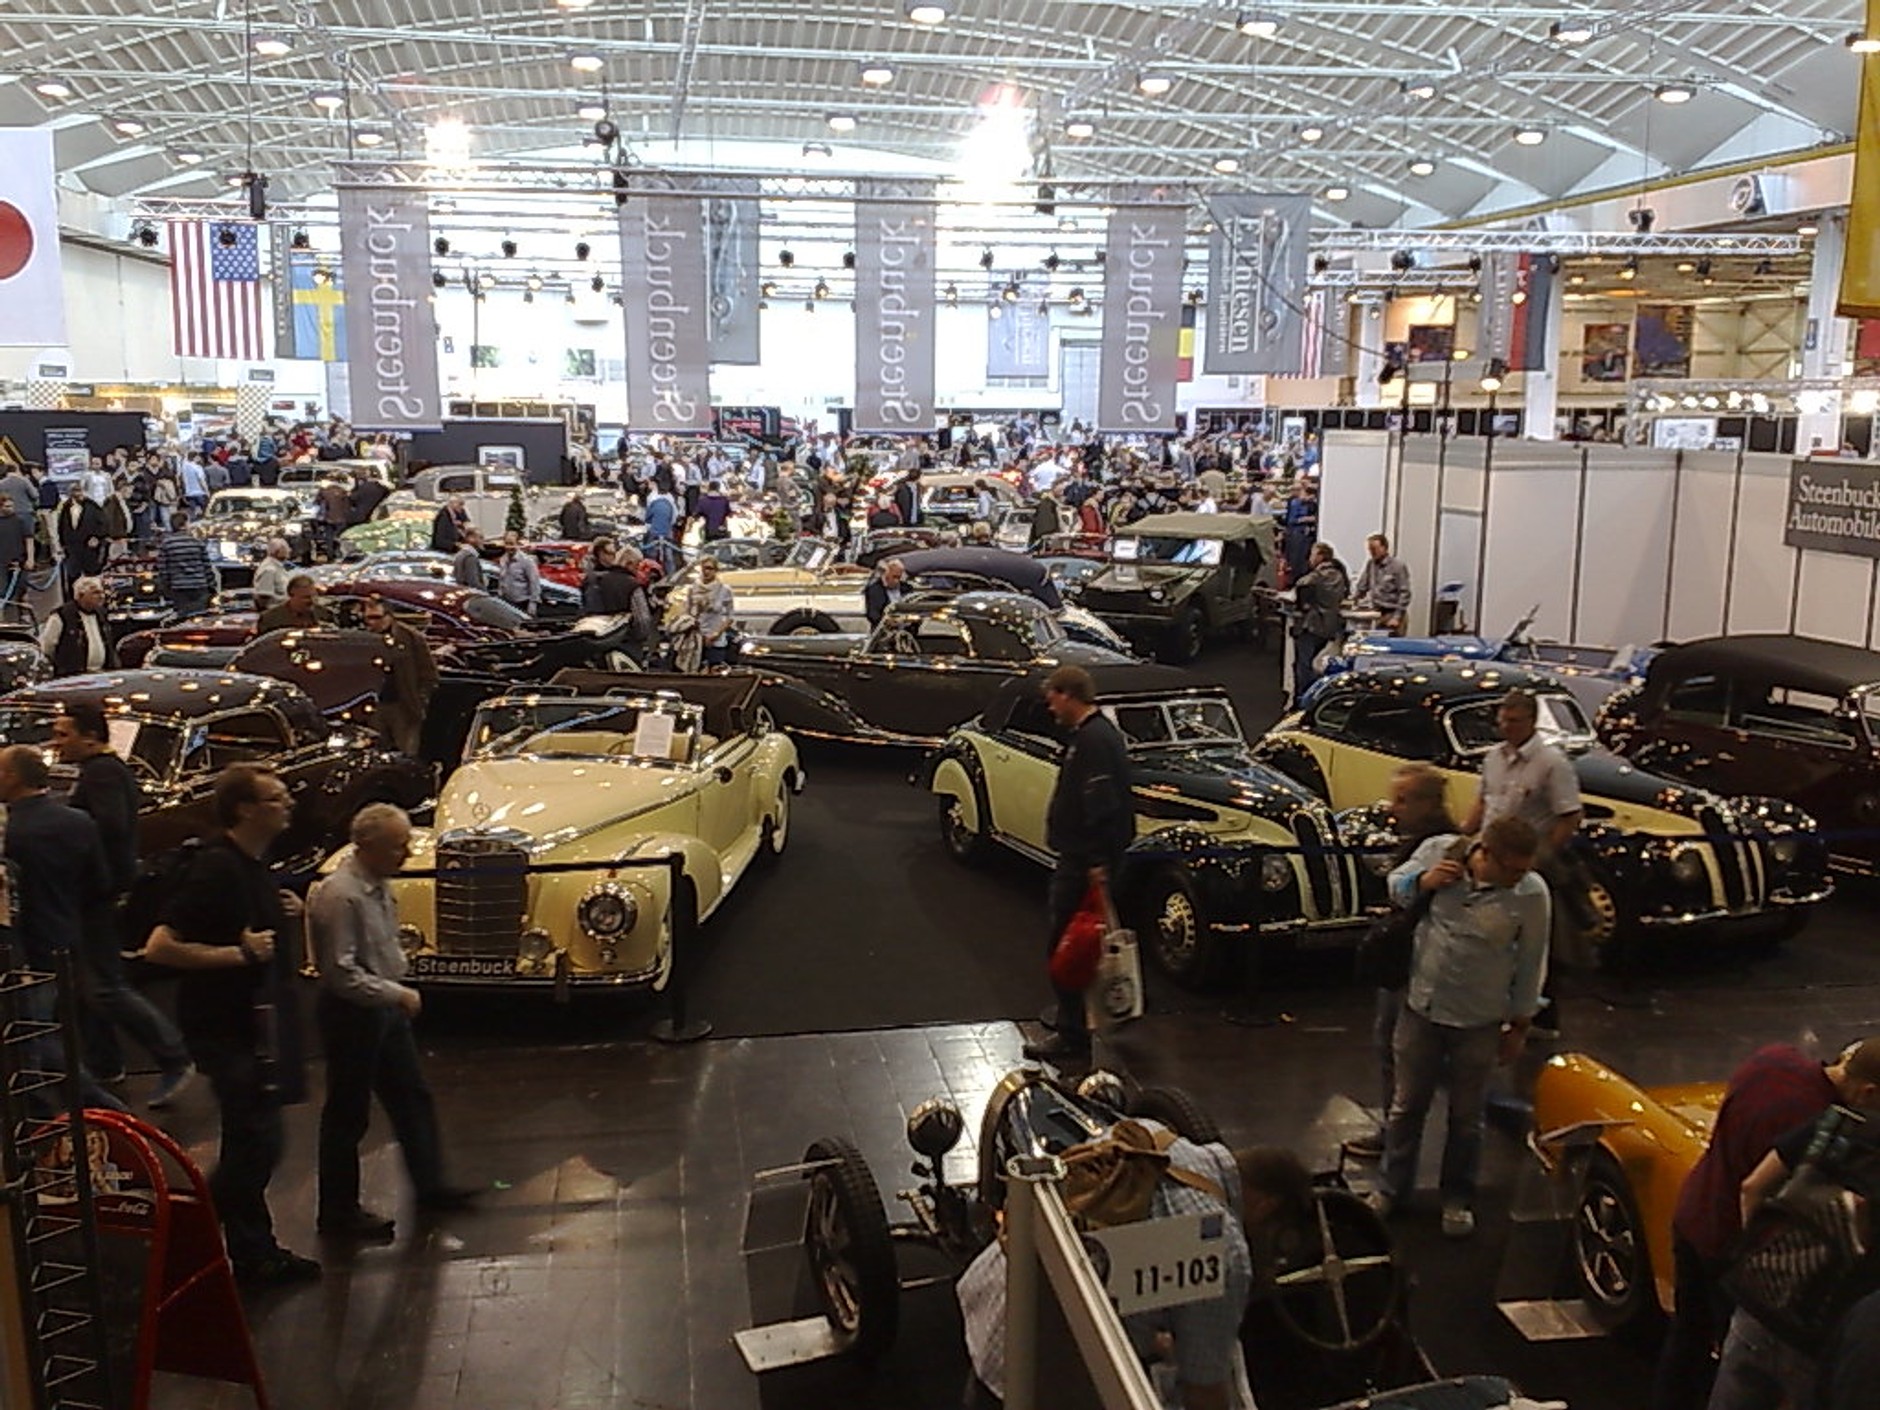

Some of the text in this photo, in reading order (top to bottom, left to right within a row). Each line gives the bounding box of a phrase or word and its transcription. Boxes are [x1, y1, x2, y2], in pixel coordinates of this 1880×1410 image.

[1798, 474, 1880, 508] Steenbuck
[417, 957, 514, 975] Steenbuck
[1134, 1254, 1220, 1296] 11-103
